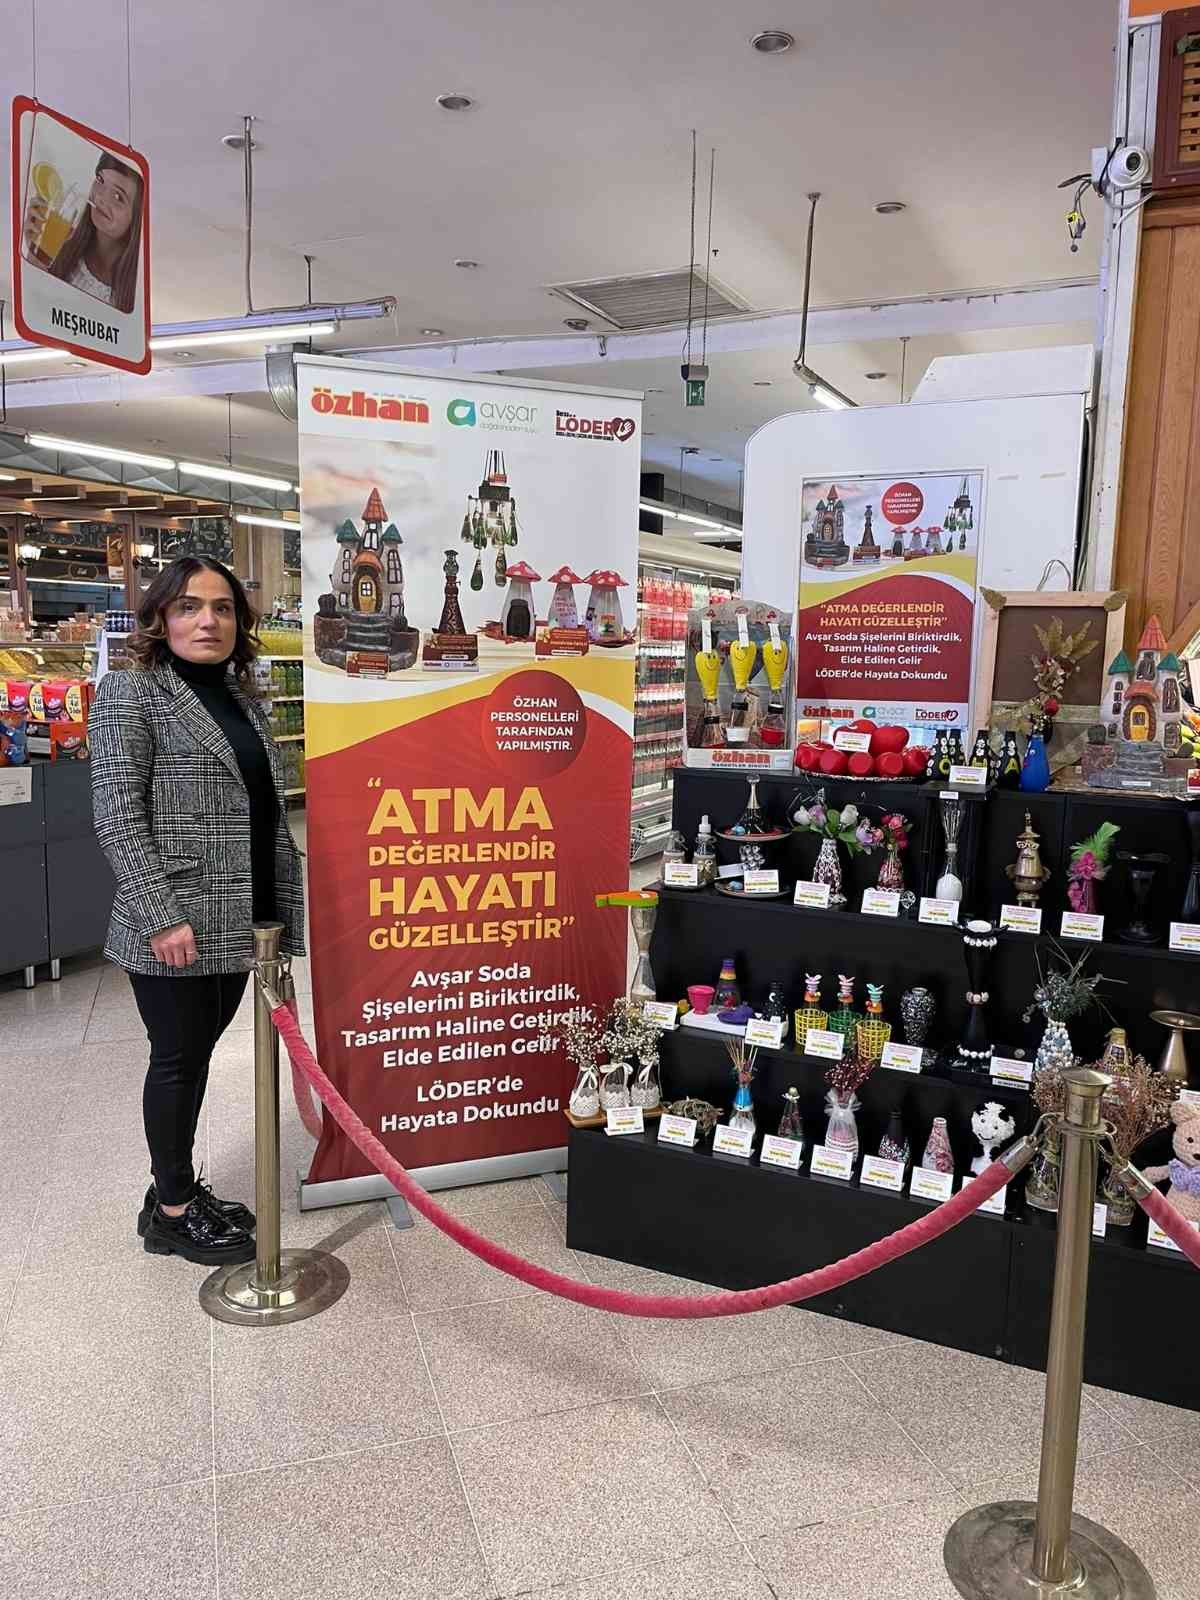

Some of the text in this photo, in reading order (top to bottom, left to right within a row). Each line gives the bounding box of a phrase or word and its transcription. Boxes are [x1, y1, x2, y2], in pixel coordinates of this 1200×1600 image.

[51, 307, 120, 344] MEŞRUBAT
[311, 387, 430, 424] özhan
[480, 401, 538, 424] avşar
[861, 601, 944, 613] DEĞERLENDİR
[820, 617, 861, 626] HAYATI
[805, 633, 832, 643] Avşar
[834, 632, 858, 641] Soda
[859, 632, 906, 643] Şişelerini
[823, 644, 861, 653] Tasarım
[863, 644, 896, 653] Haline
[841, 655, 922, 665] Elde Edilen Gelir
[864, 670, 899, 680] Hayata
[901, 670, 948, 680] Dokundu
[513, 695, 558, 708] ÖZHAN
[490, 710, 579, 722] PERSONELLERİ
[495, 726, 573, 736] TARAFINDAN
[495, 740, 573, 753] YAPILMIŞTIR.
[368, 835, 556, 867] DEĞERLENDİR
[368, 871, 556, 917] HAYATI
[411, 962, 532, 990] Avşar Soda
[362, 983, 580, 1024] Şişelerini Biriktirdik,
[341, 1025, 430, 1048] Tasarım
[436, 1015, 505, 1038] Haline
[383, 1048, 433, 1069] Elde
[438, 1042, 506, 1063] Edilen
[381, 1096, 560, 1133] Hayata Dokundu
